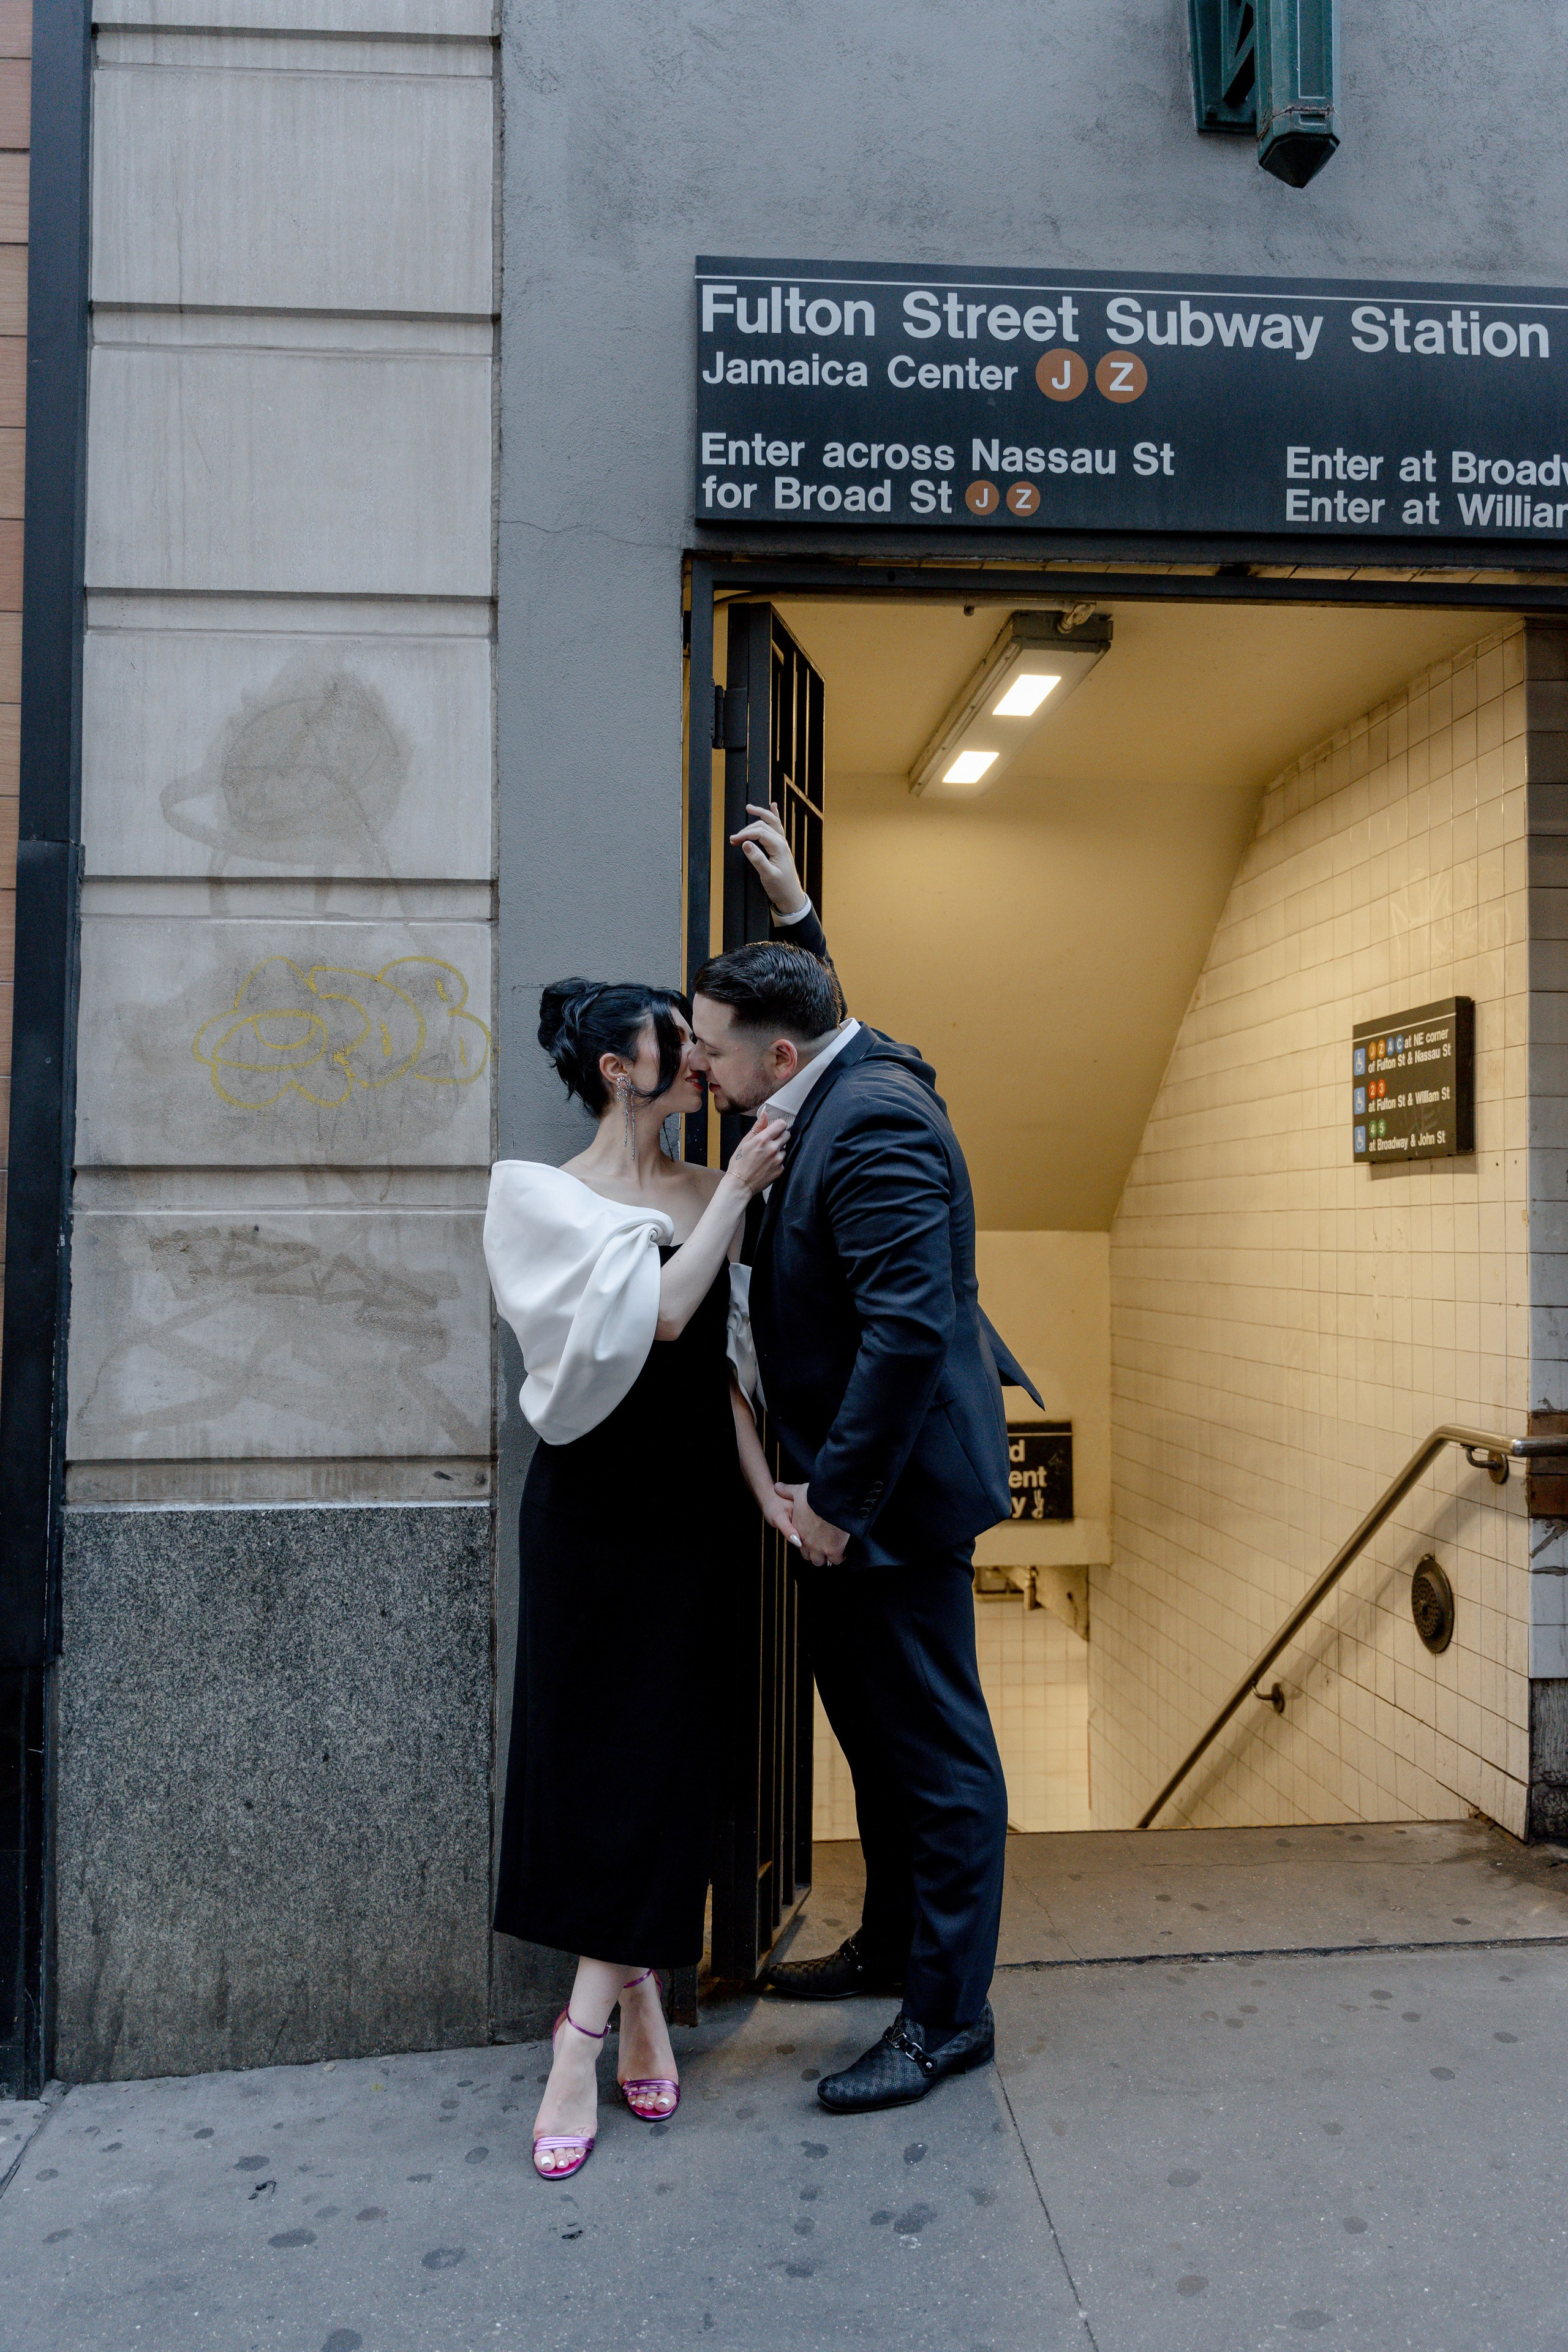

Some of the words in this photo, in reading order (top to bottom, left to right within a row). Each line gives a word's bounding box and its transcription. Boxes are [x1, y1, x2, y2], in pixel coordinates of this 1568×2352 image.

[702, 284, 875, 336] Fulton
[902, 290, 1079, 342] Street
[1106, 296, 1324, 360] Subway
[1351, 306, 1550, 358] Station
[703, 351, 868, 386] Jamaica
[888, 355, 1018, 390] Center
[1051, 360, 1071, 390] J
[1109, 361, 1134, 392] Z
[702, 432, 804, 467] Enter
[823, 442, 955, 471] across
[972, 439, 1116, 474] Nassau
[1133, 442, 1174, 475] St
[1287, 446, 1384, 481] Enter
[1399, 450, 1436, 482] at
[702, 475, 758, 508] for
[775, 477, 891, 512] Broad
[910, 480, 952, 513] St
[975, 488, 989, 508] J
[1016, 489, 1031, 509] Z
[1286, 489, 1385, 523] Enter
[1402, 492, 1440, 524] at
[1368, 1059, 1376, 1074] of
[1376, 1057, 1396, 1071] Fulton
[1397, 1053, 1406, 1067] St
[1407, 1051, 1414, 1065] &
[1414, 1048, 1441, 1063] Nassau
[1442, 1042, 1452, 1057] St
[1370, 1046, 1374, 1057] J
[1379, 1044, 1384, 1054] Z
[1387, 1041, 1393, 1052] A
[1396, 1038, 1402, 1050] C
[1404, 1035, 1412, 1049] at
[1413, 1032, 1424, 1047] NE
[1425, 1028, 1449, 1043] corner
[1368, 1099, 1376, 1113] at
[1376, 1097, 1396, 1111] Fulton
[1397, 1094, 1406, 1108] St
[1407, 1092, 1414, 1107] &
[1415, 1090, 1439, 1105] William
[1441, 1086, 1450, 1101] St
[1370, 1084, 1375, 1096] 2
[1379, 1082, 1384, 1094] 3
[1368, 1139, 1377, 1152] at
[1377, 1136, 1409, 1151] Broadway
[1410, 1134, 1416, 1147] &
[1417, 1132, 1435, 1147] John
[1436, 1130, 1446, 1144] St
[1370, 1123, 1376, 1136] 4
[1379, 1122, 1384, 1133] 5
